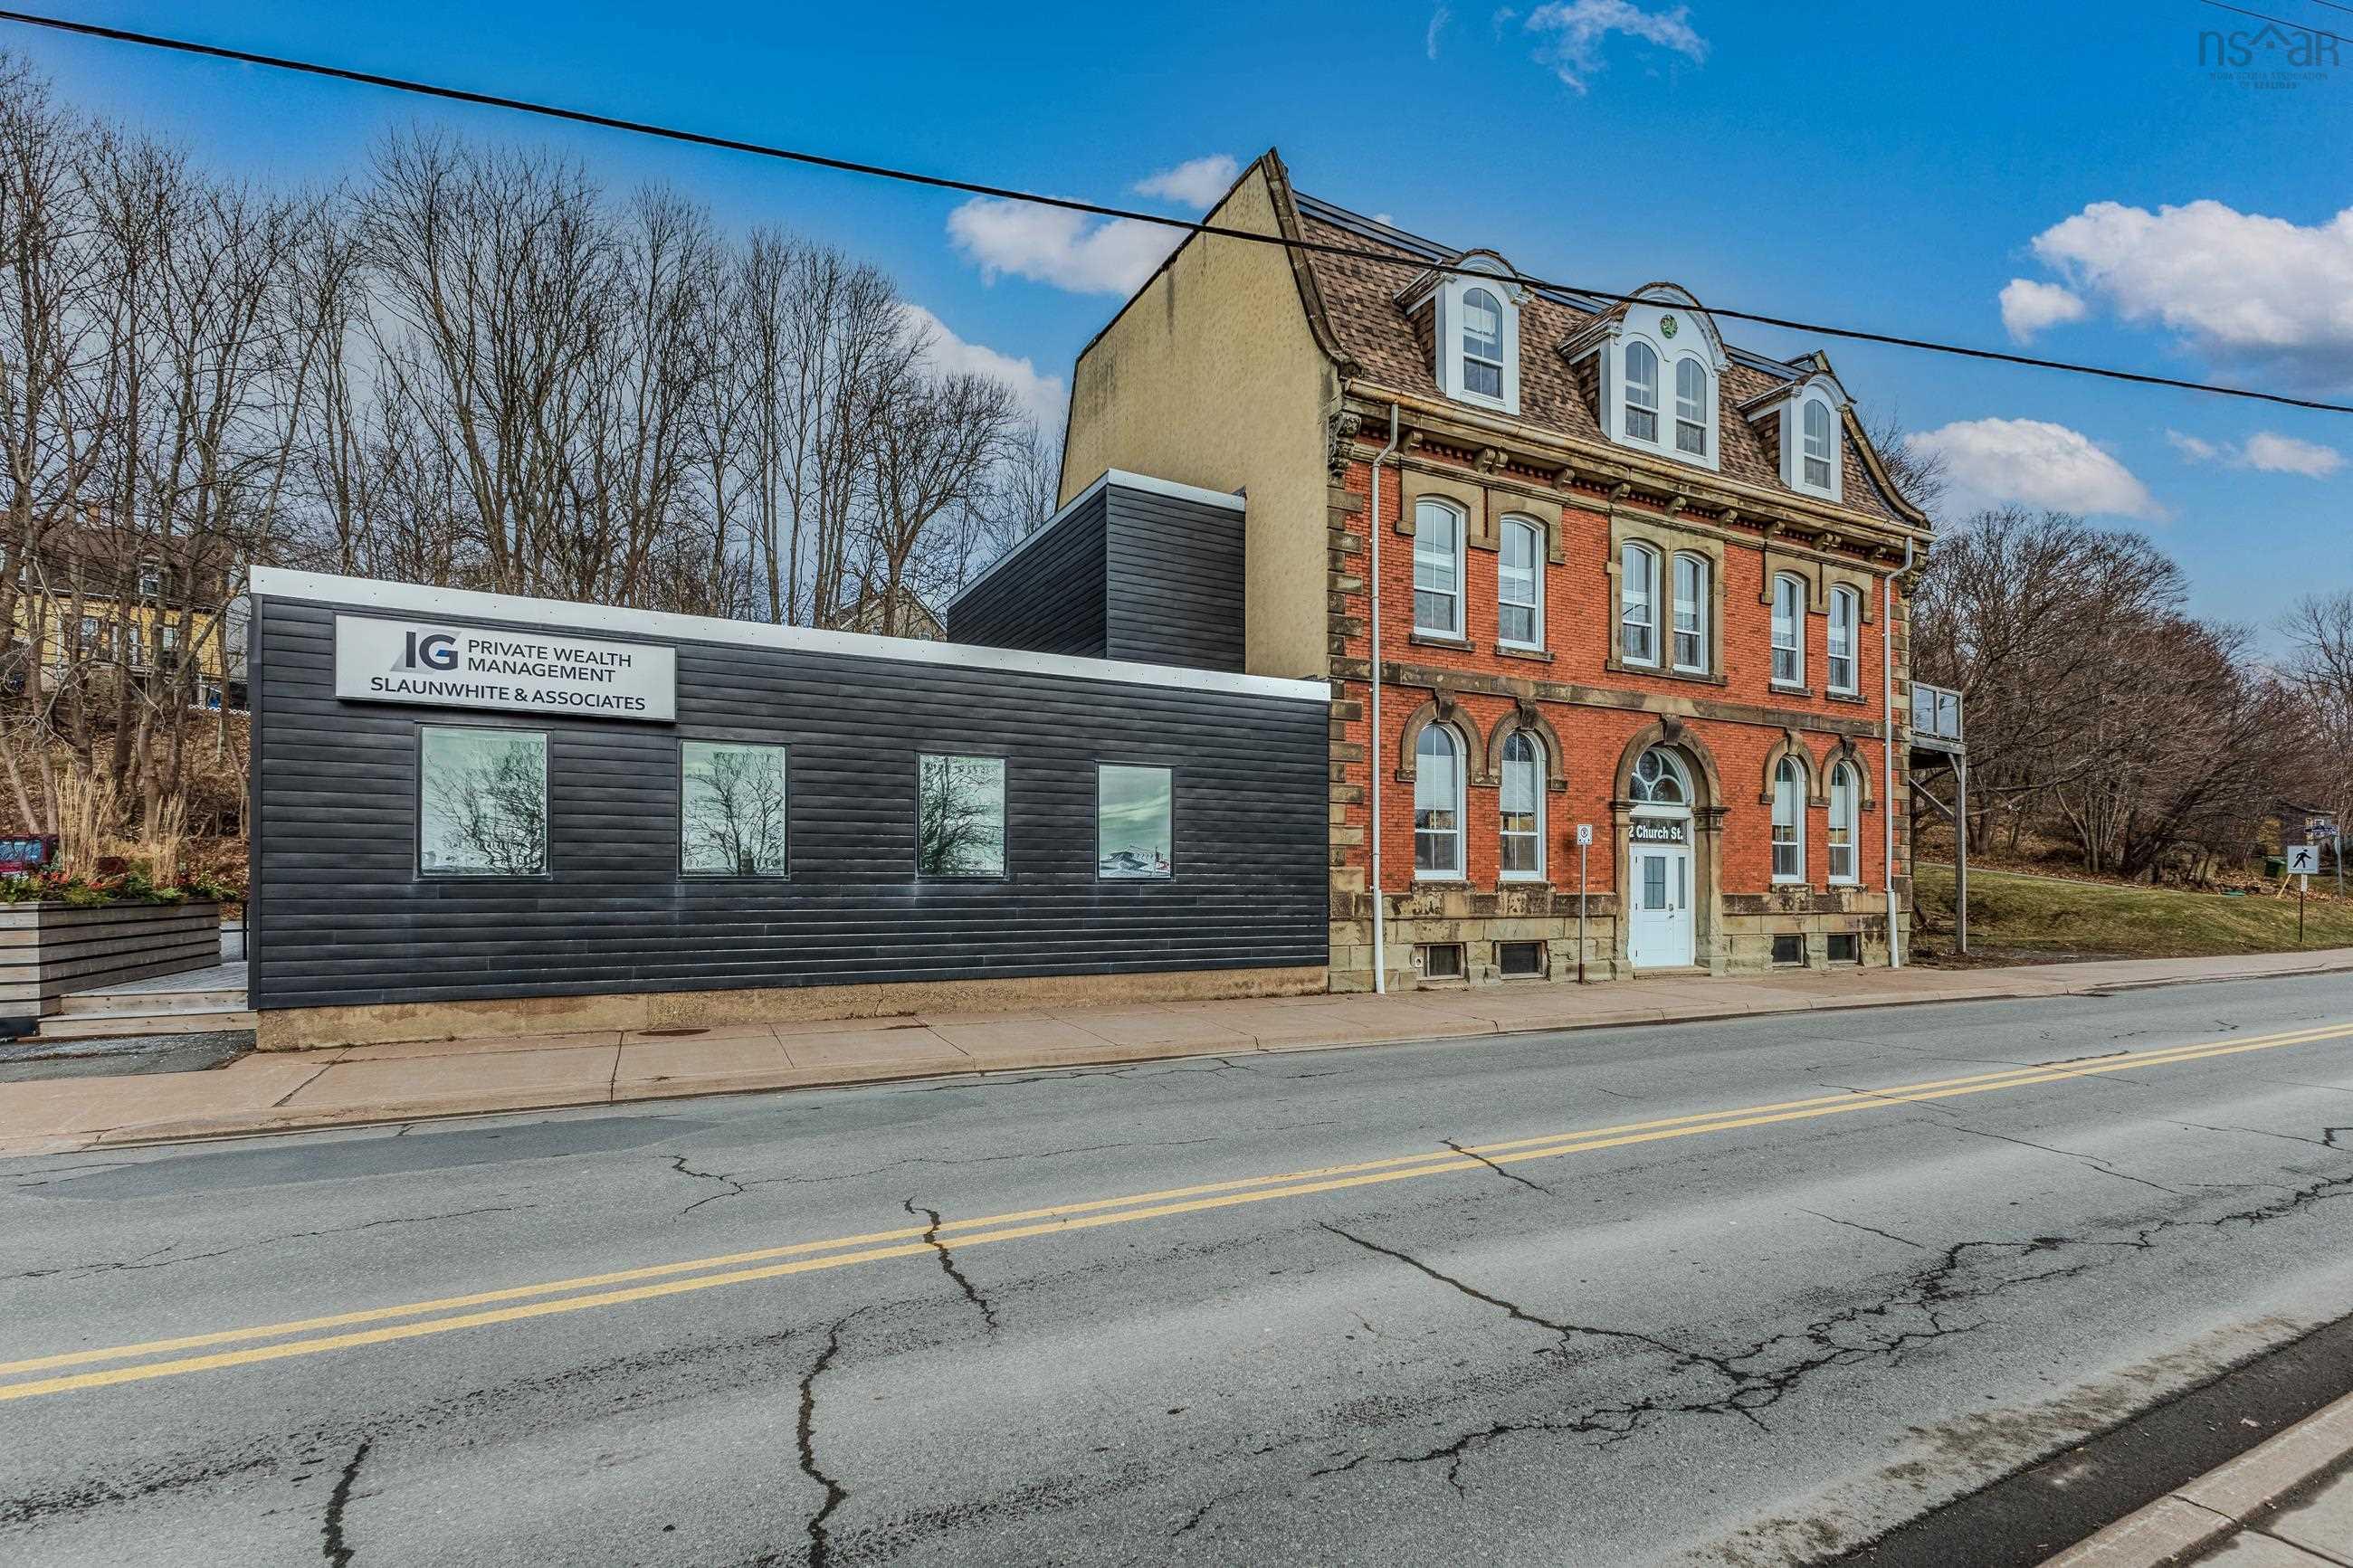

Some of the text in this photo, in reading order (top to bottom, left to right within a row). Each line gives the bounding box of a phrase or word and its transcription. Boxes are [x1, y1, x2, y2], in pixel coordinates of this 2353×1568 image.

[405, 631, 459, 671] IG
[468, 639, 632, 668] PRIVATE WEALTH
[467, 657, 616, 683] MANAGEMENT
[370, 676, 646, 711] SLAUNWHITE & ASSOCIATES
[1636, 824, 1669, 840] Church
[1671, 826, 1683, 840] St.
